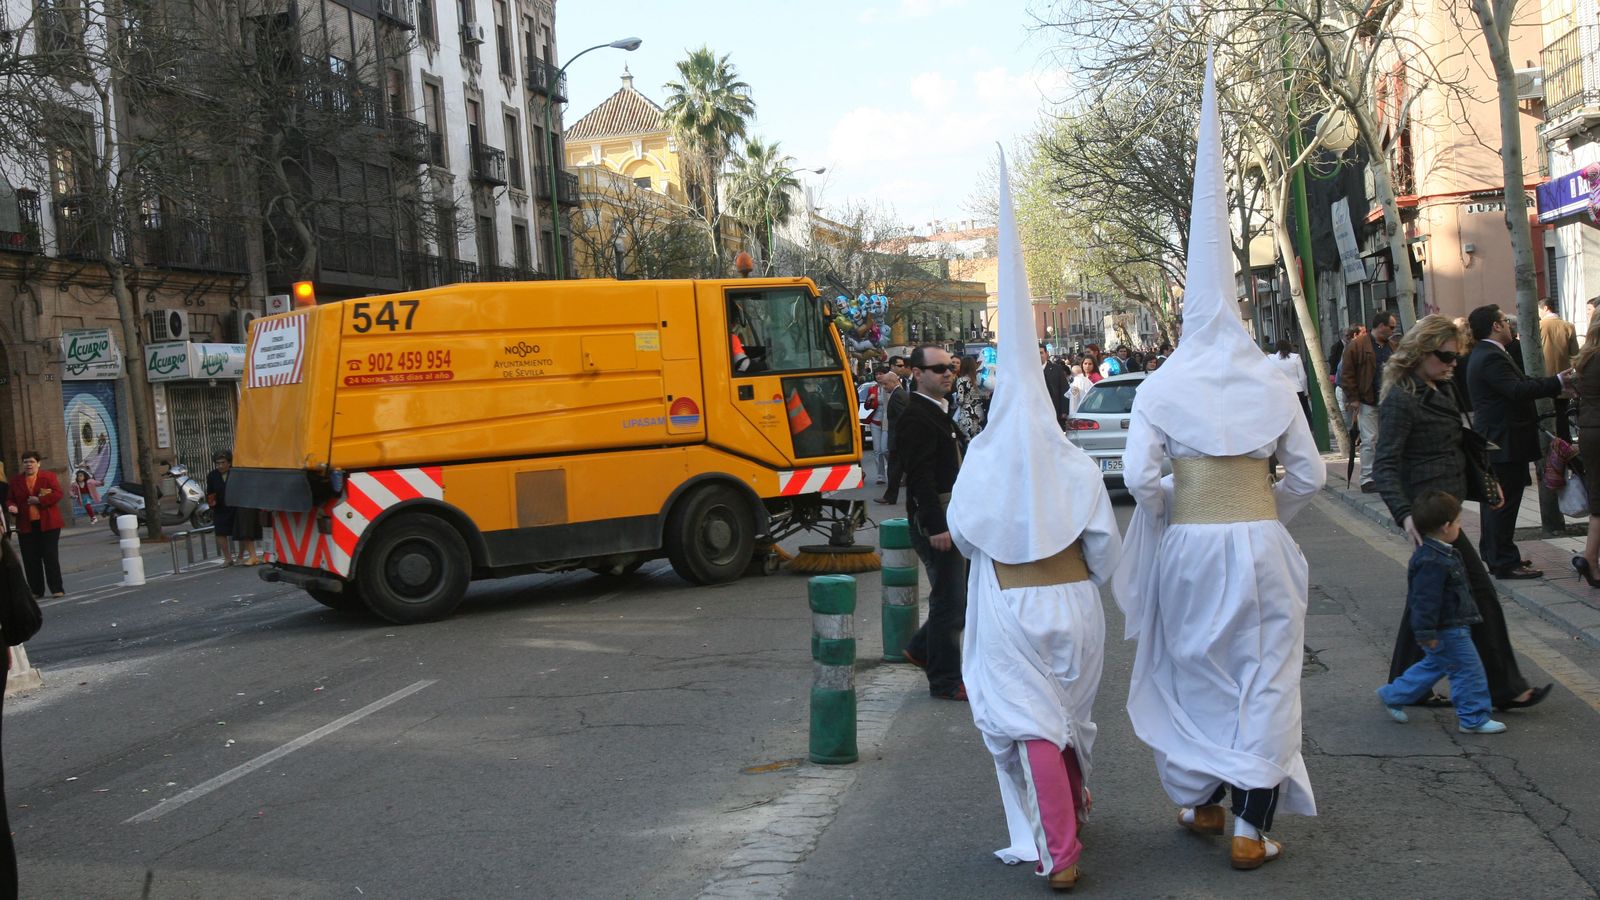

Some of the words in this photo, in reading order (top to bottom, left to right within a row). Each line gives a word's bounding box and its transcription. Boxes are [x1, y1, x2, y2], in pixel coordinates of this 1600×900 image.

[352, 300, 420, 333] 547
[368, 352, 393, 372] 902
[397, 350, 423, 370] 459
[427, 349, 451, 369] 954
[348, 377, 359, 385] 24
[389, 374, 404, 382] 365
[502, 369, 513, 378] DE
[623, 416, 667, 429] LIPASAM
